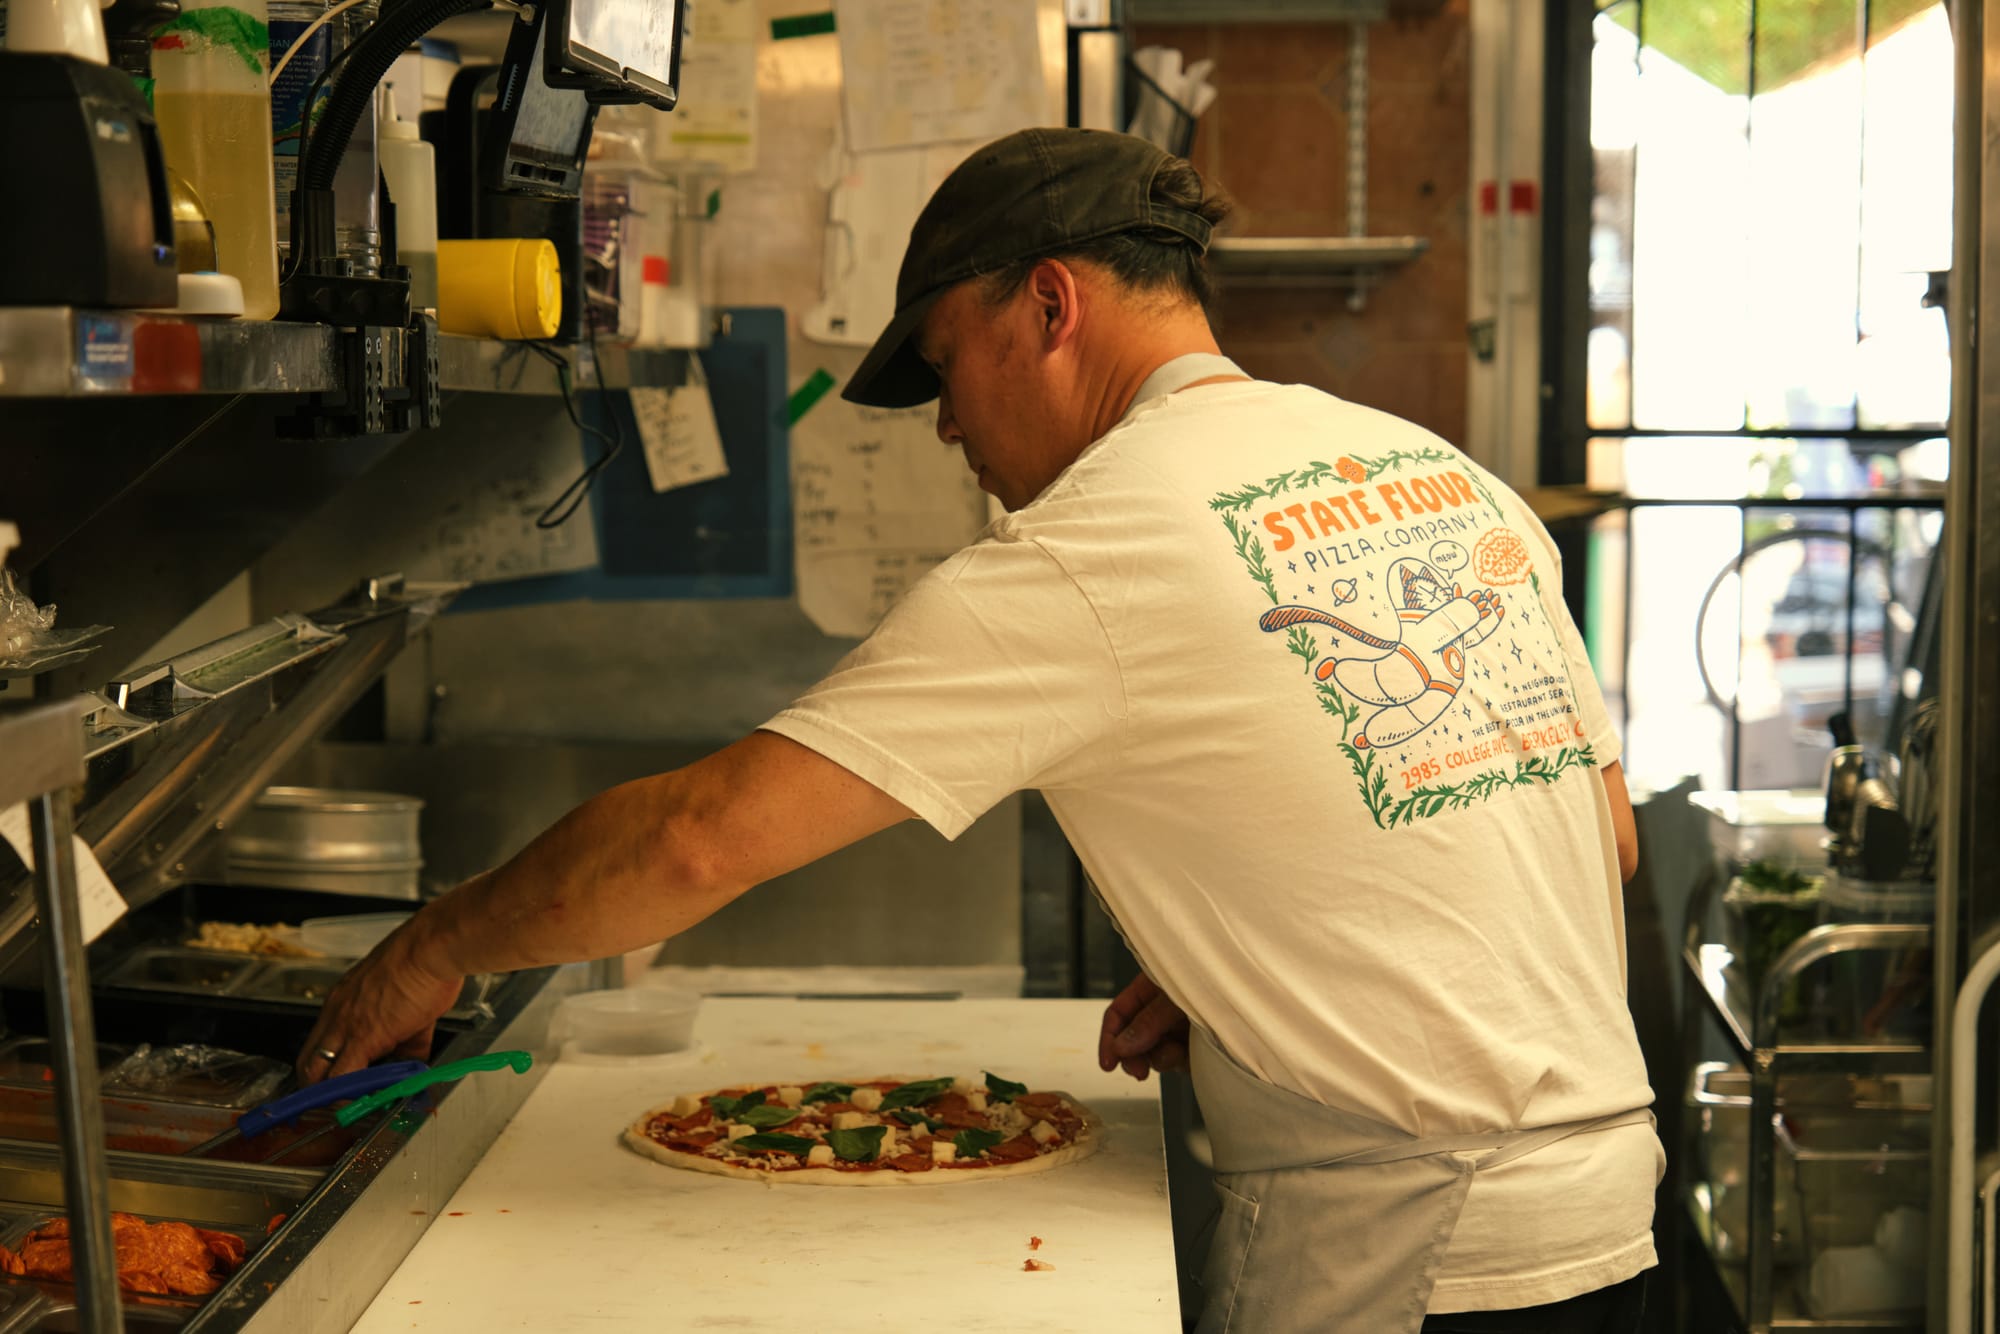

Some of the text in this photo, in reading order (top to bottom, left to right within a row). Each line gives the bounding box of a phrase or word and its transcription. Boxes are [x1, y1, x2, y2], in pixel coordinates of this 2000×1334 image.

[1263, 471, 1480, 552] STATE FLOUR
[1512, 685, 1520, 696] A
[1472, 726, 1485, 738] THE
[1485, 720, 1501, 734] BEST
[1525, 712, 1535, 725] IN
[1400, 756, 1441, 790] 2985
[1445, 741, 1492, 769] COLLEGE
